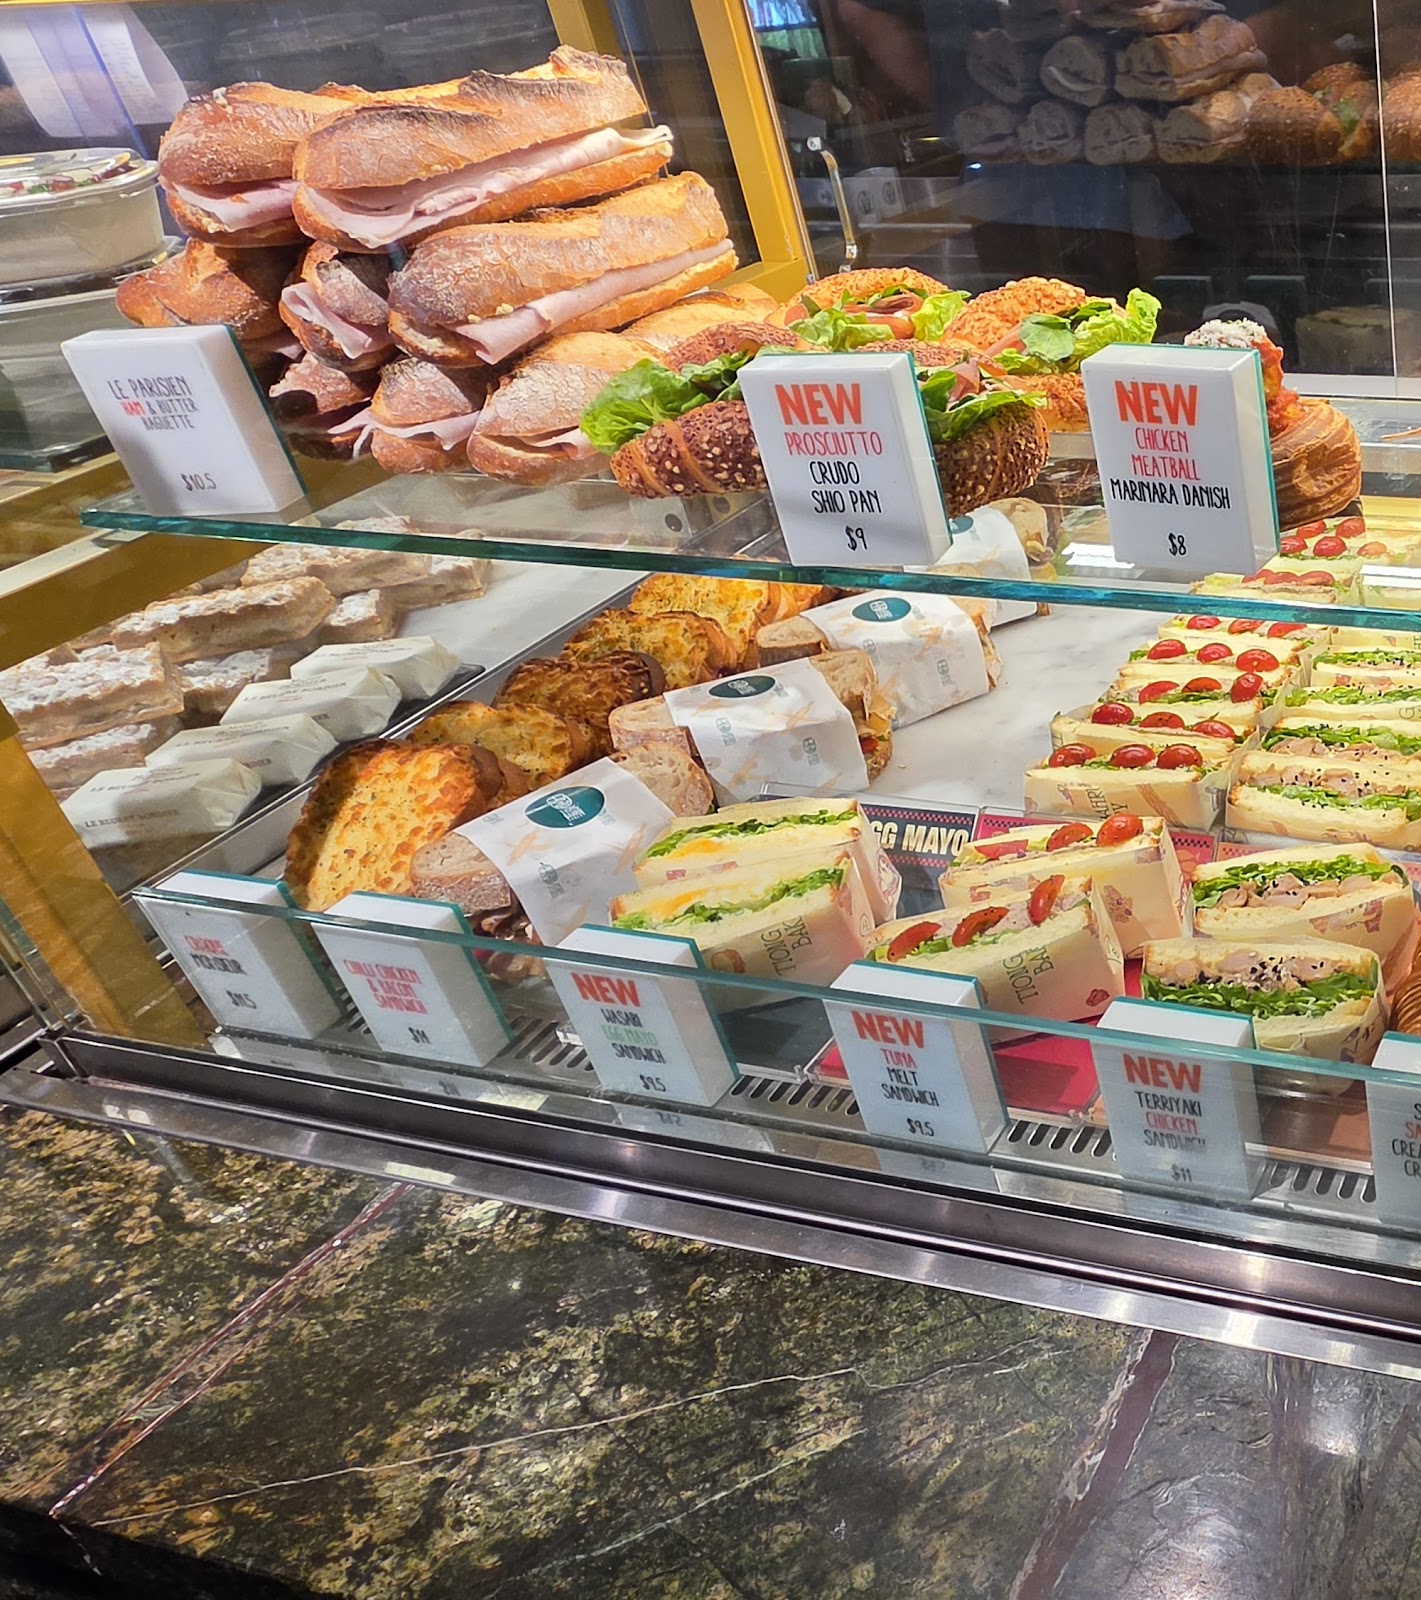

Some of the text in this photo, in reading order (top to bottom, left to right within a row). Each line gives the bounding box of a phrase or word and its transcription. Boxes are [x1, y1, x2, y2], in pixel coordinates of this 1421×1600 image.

[107, 376, 193, 400] LE PARISIEN
[120, 398, 199, 415] HAM & BUTTER
[775, 383, 863, 425] NEW
[1114, 380, 1198, 426] NEW
[141, 415, 195, 431] BAGUETTE
[784, 431, 883, 456] PROSCIUTTO
[1135, 427, 1189, 453] CHICKEN
[809, 461, 860, 485] CRUDO
[1131, 454, 1201, 481] MEATBALL
[811, 489, 882, 514] SHIO PAN
[1110, 478, 1231, 509] MARINARA DANISH
[845, 525, 868, 551] $9
[1168, 532, 1187, 556] $8
[870, 821, 970, 857] GG MAYO
[760, 927, 796, 977] TIONG
[571, 971, 641, 1008] NEW
[1003, 949, 1039, 1005] TIONG
[600, 1008, 644, 1028] WASABI
[851, 1010, 925, 1049] NEW
[625, 1027, 659, 1047] MAYO
[611, 1042, 667, 1064] SANDWICH
[880, 1048, 918, 1069] TUNA
[886, 1067, 918, 1086] MELT
[1122, 1053, 1202, 1093] NEW
[881, 1083, 939, 1107] SANDWICH
[1134, 1090, 1203, 1117] TERRIYAKI
[1145, 1111, 1198, 1135] CHICKEN
[1171, 1163, 1193, 1183] $11
